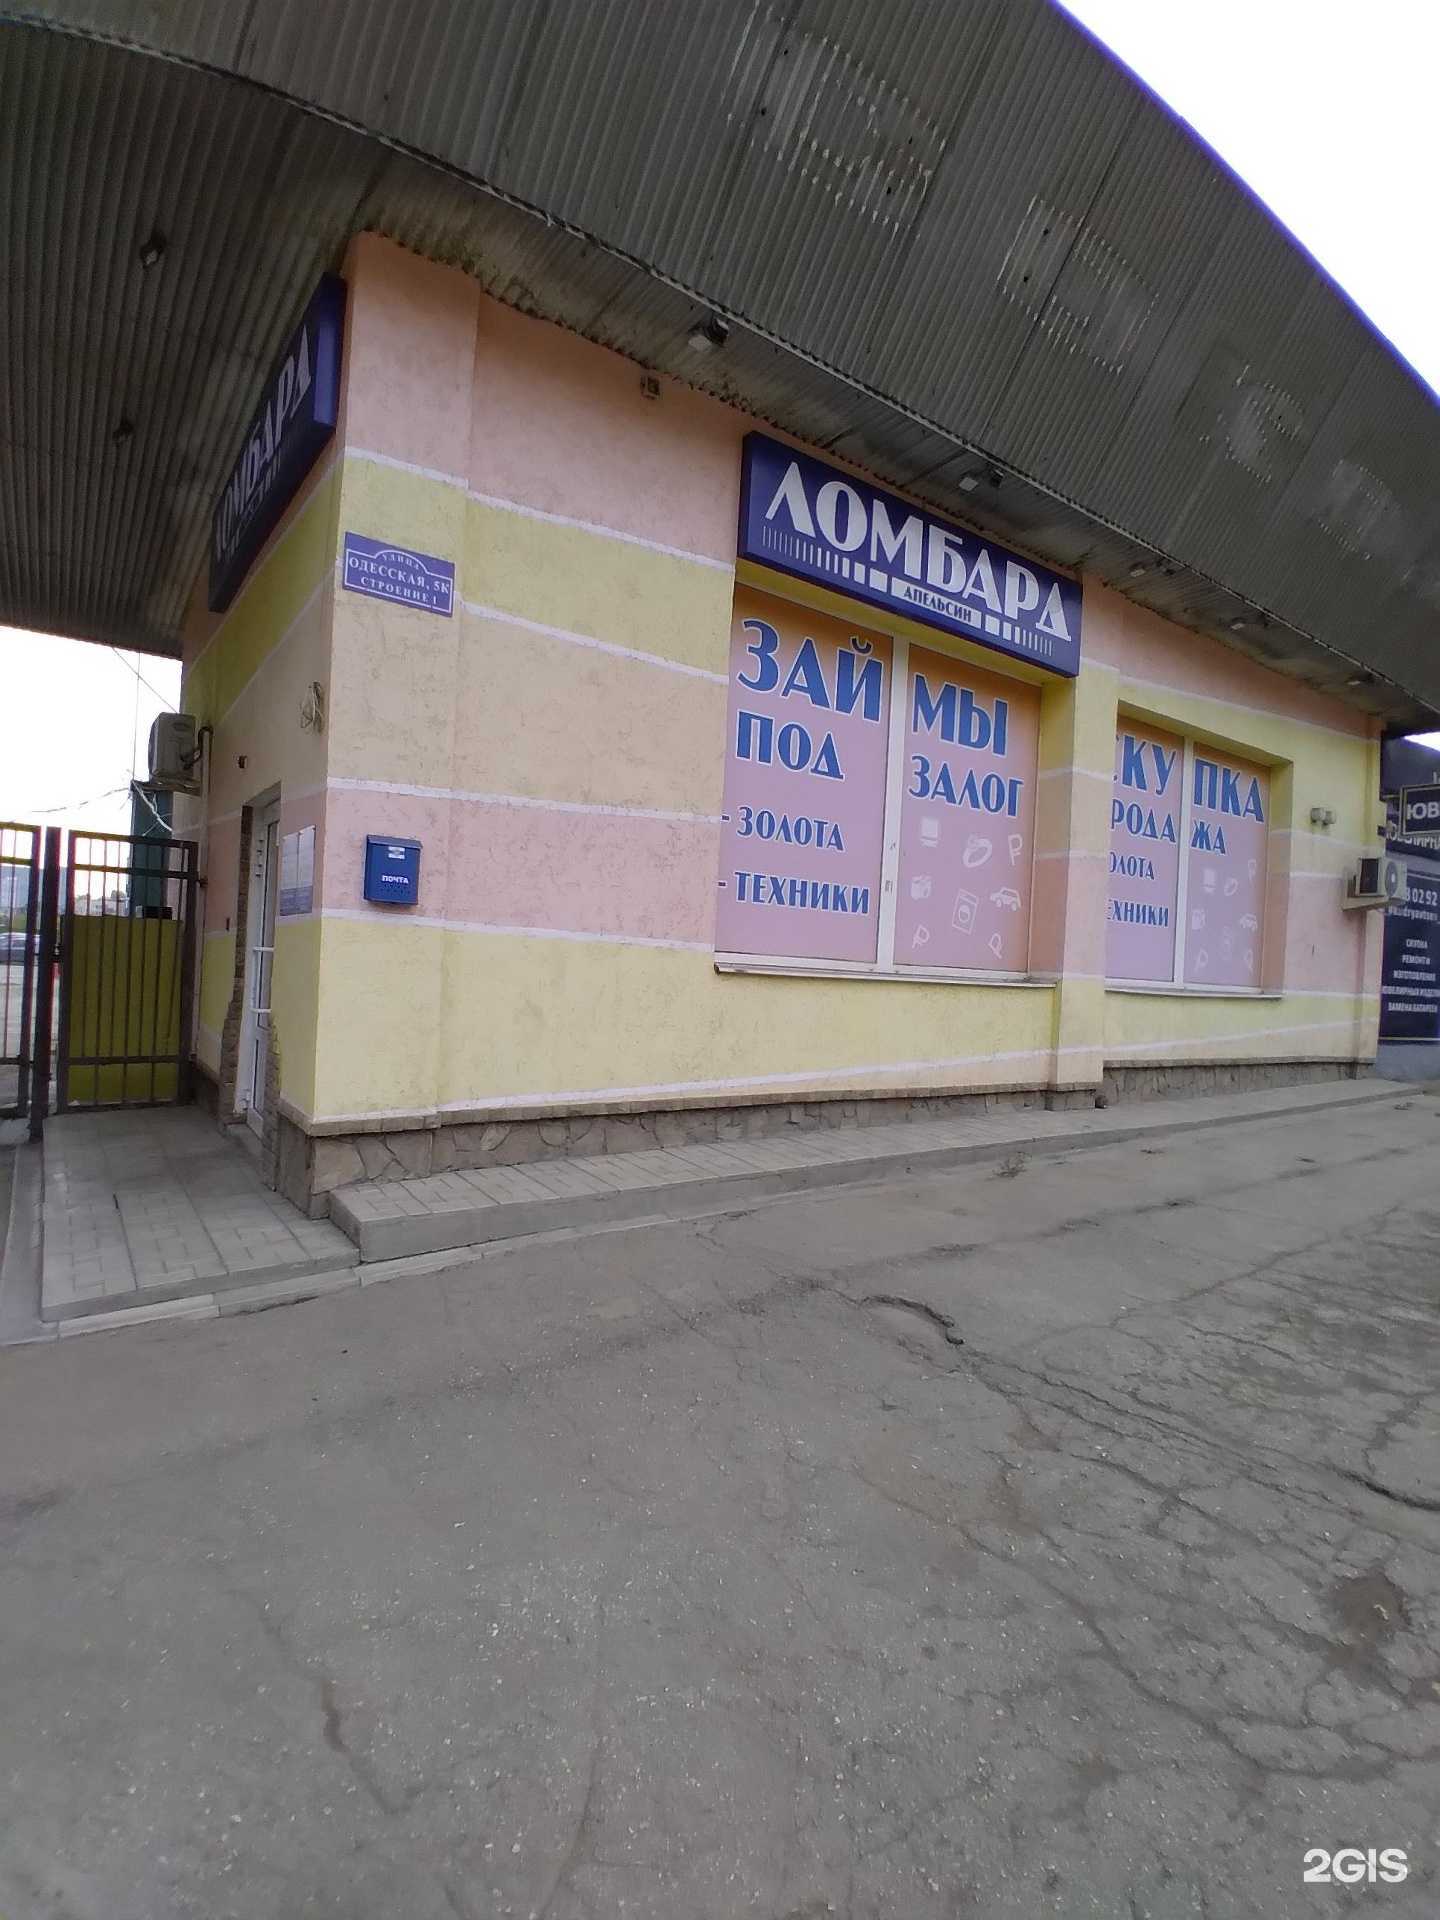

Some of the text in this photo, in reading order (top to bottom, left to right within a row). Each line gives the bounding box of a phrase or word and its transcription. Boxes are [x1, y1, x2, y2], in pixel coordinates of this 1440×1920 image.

[765, 461, 1072, 642] ЛОМБАРД
[349, 557, 430, 590] ОДЕССКАЯ,
[361, 576, 428, 602] СТРОЕНИЕ
[903, 586, 973, 623] АПЕЛЬСИН
[736, 710, 1025, 817] ПОД ЗАЛОГ
[1113, 734, 1265, 822] КУ ПКА
[736, 806, 845, 851] ЗОЛОТА
[1191, 819, 1226, 855] ЖА
[381, 875, 409, 884] ПОЧТА
[734, 870, 870, 915] ТЕХНИКИ
